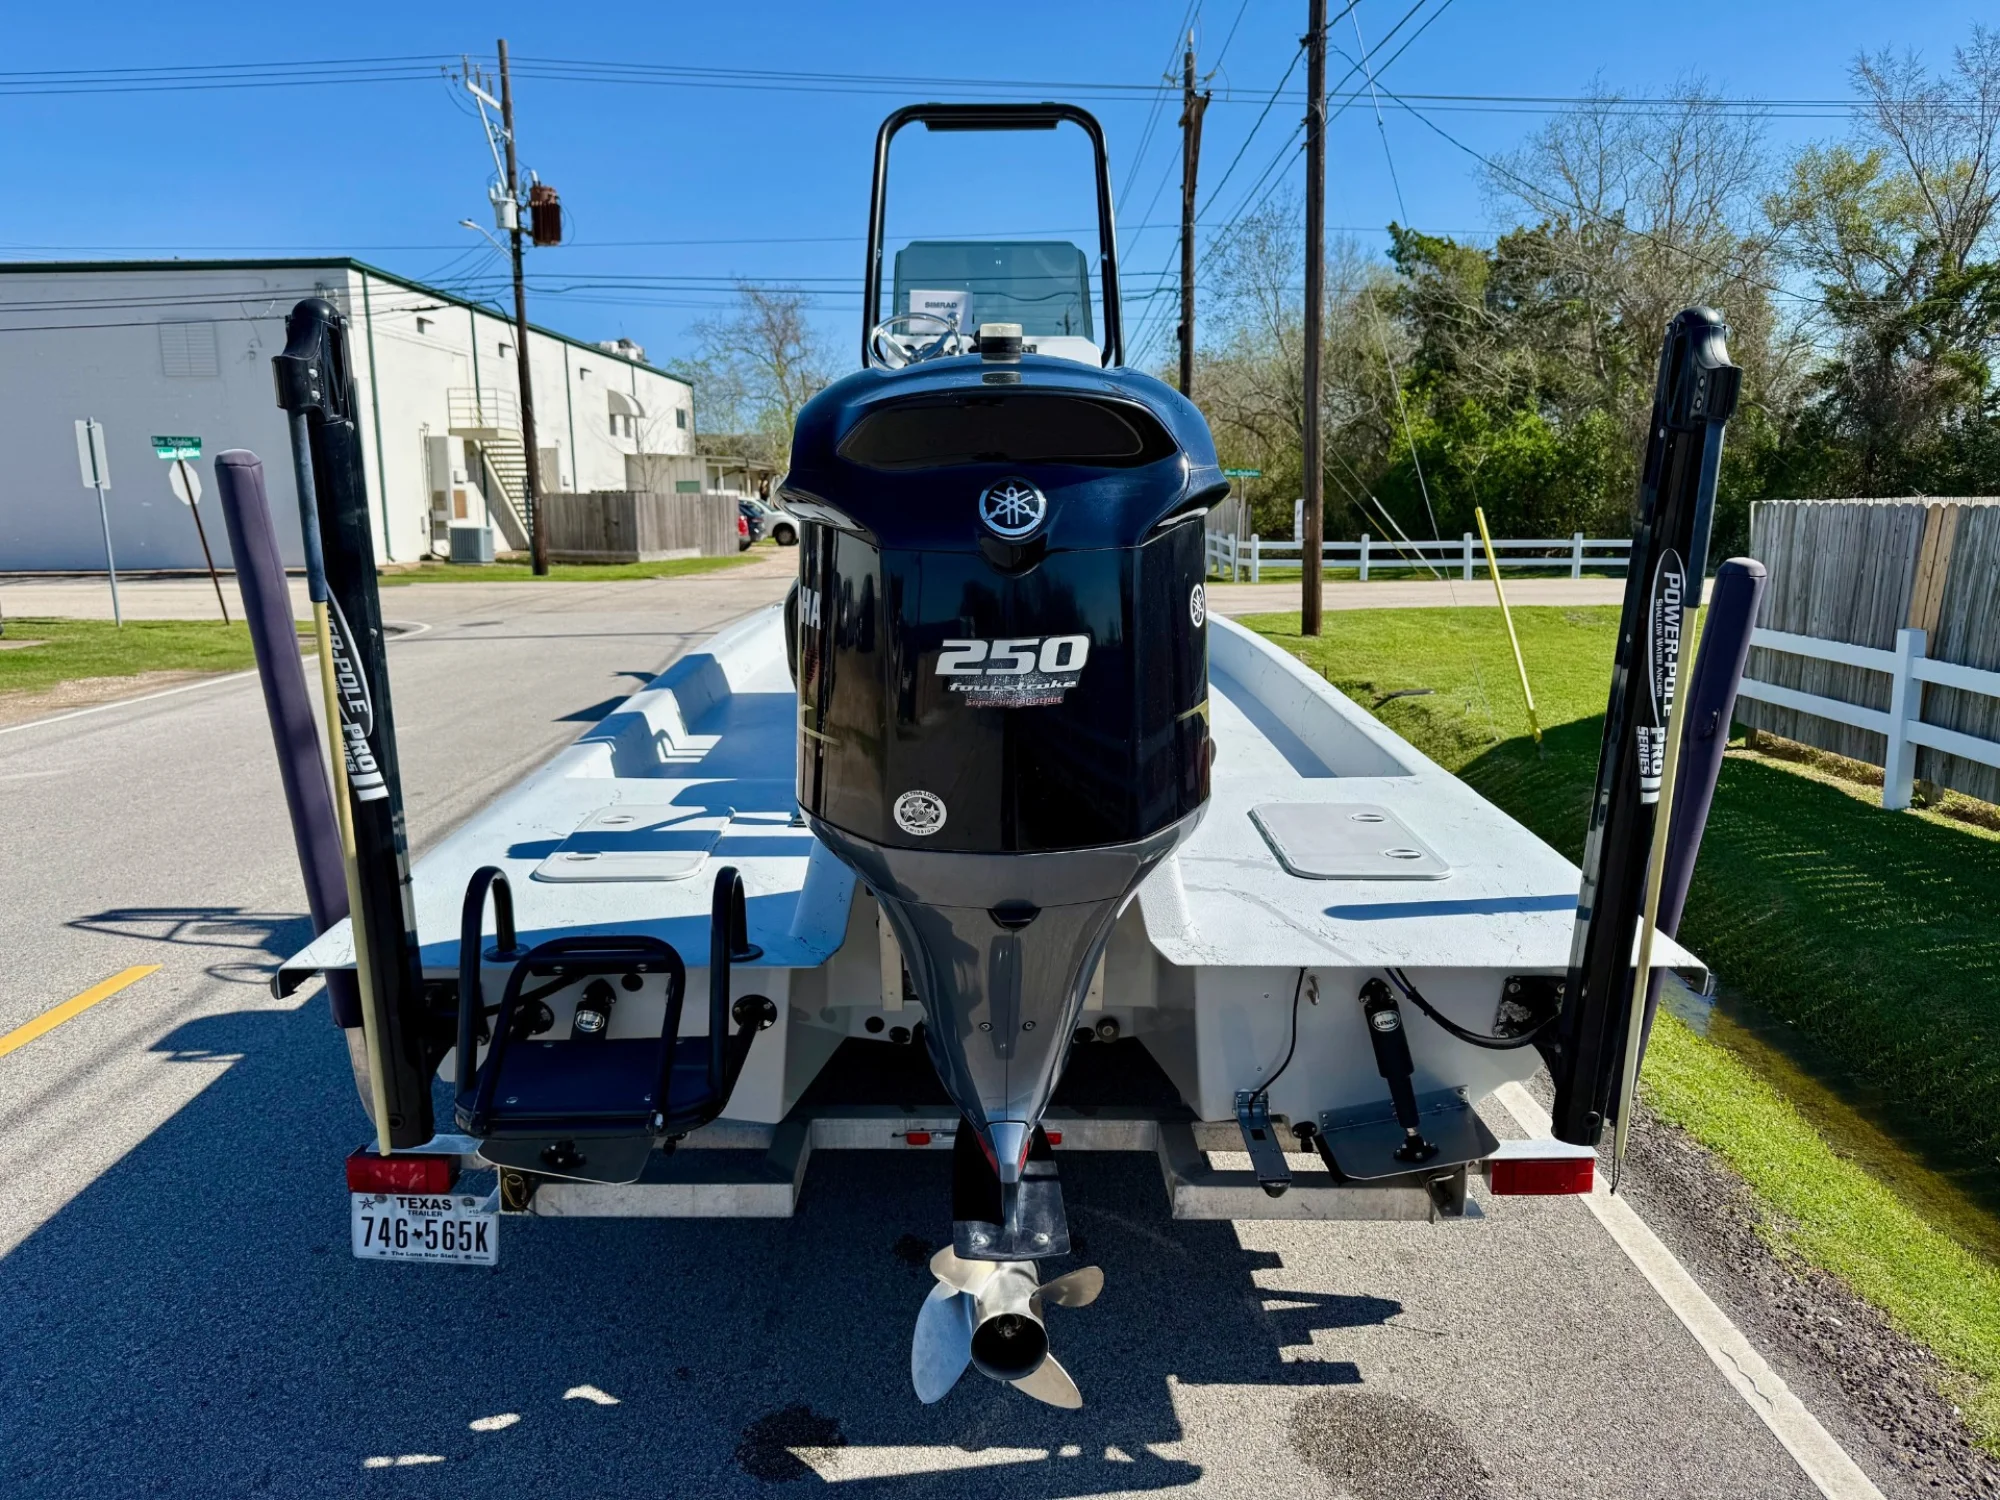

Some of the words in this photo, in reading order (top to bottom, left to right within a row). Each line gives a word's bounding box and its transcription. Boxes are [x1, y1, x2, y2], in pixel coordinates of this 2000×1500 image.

[924, 301, 958, 309] SIMRAD
[935, 635, 1090, 675] 250
[1663, 571, 1681, 717] POWER-POLE
[342, 722, 378, 773] PRO
[1635, 725, 1651, 776] SERIES
[1650, 726, 1666, 776] PRO
[396, 1196, 453, 1211] TEXAS
